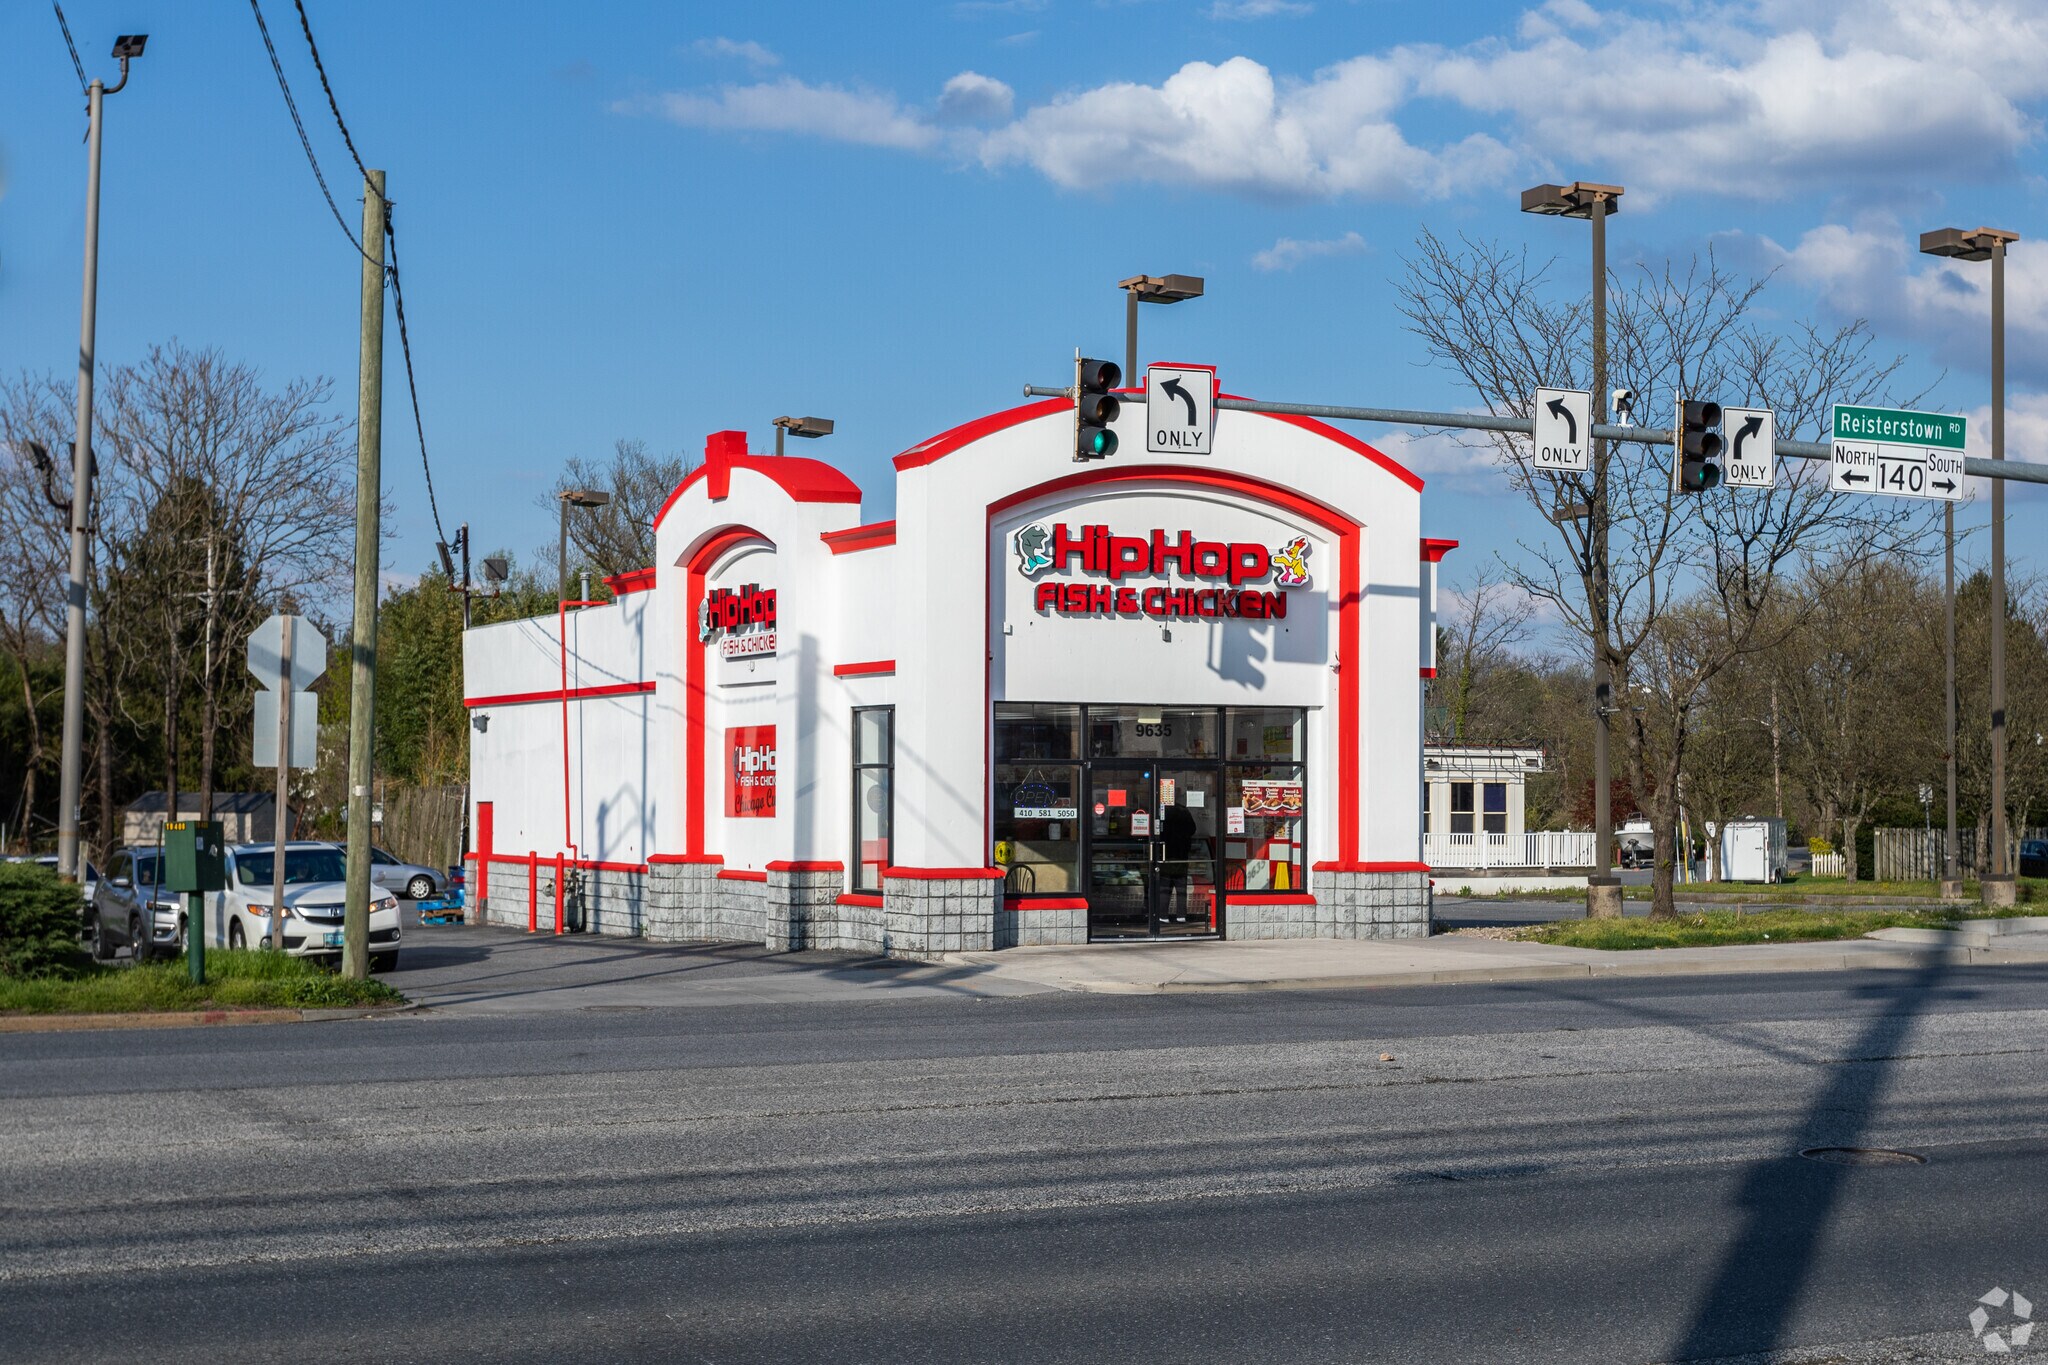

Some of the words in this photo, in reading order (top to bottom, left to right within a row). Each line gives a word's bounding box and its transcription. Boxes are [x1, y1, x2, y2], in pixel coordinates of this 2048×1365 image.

[1841, 412, 1942, 440] Reisterstown
[1949, 422, 1961, 434] RD
[1156, 429, 1203, 448] ONLY
[1541, 446, 1582, 465] ONLY
[1834, 445, 1876, 467] NORTH
[1928, 453, 1963, 475] SOUTH
[1730, 463, 1768, 481] ONLY
[1879, 462, 1924, 493] 140
[1053, 523, 1269, 586] HipHop
[1035, 582, 1112, 614] FISH
[1114, 587, 1140, 614] &
[708, 583, 777, 634] HipHop
[722, 639, 740, 656] FISH
[1135, 723, 1172, 738] 9635
[740, 776, 754, 787] FISH
[735, 795, 765, 816] Chicago
[1015, 790, 1056, 805] OPEN
[1057, 810, 1075, 818] 5050
